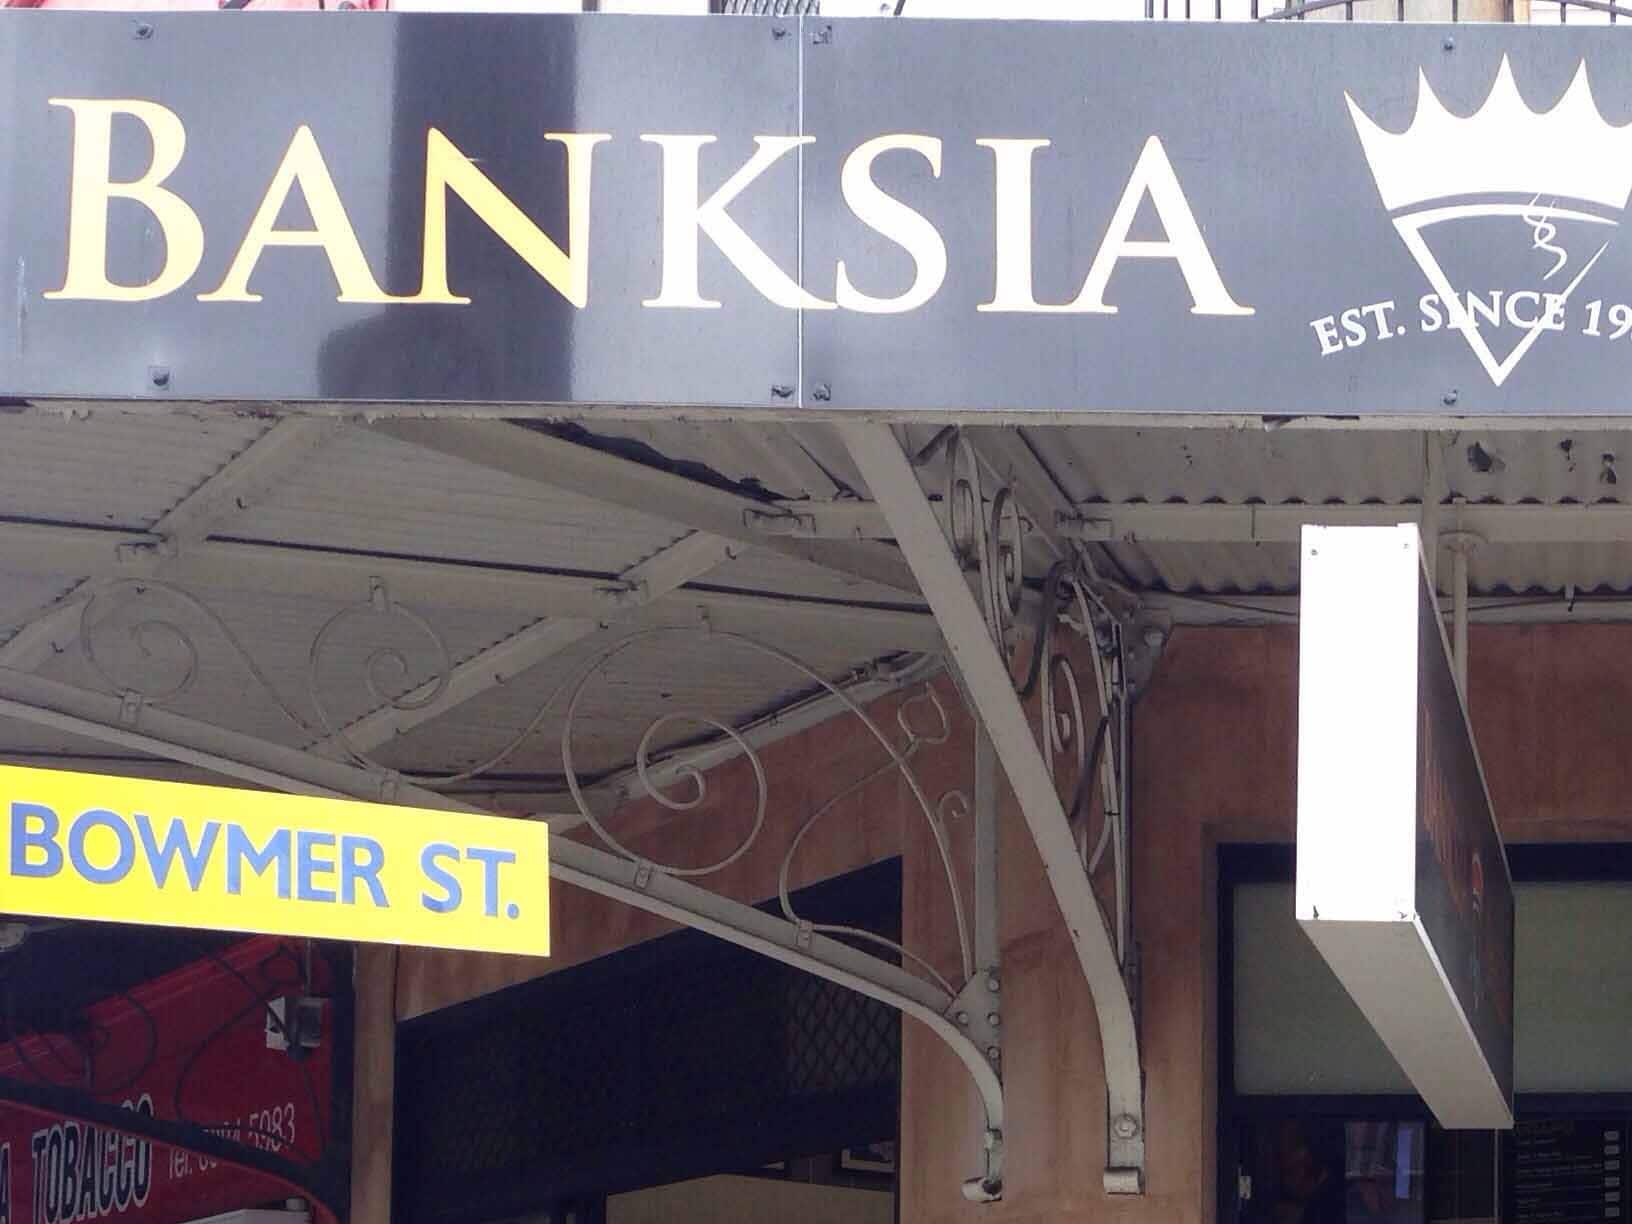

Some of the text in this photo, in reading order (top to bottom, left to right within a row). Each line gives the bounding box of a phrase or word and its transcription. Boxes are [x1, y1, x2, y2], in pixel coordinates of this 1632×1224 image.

[43, 98, 1256, 316] BANKSIA
[1309, 300, 1406, 357] EST.
[1419, 289, 1567, 333] SINCE
[9, 801, 521, 921] BOWMER ST.
